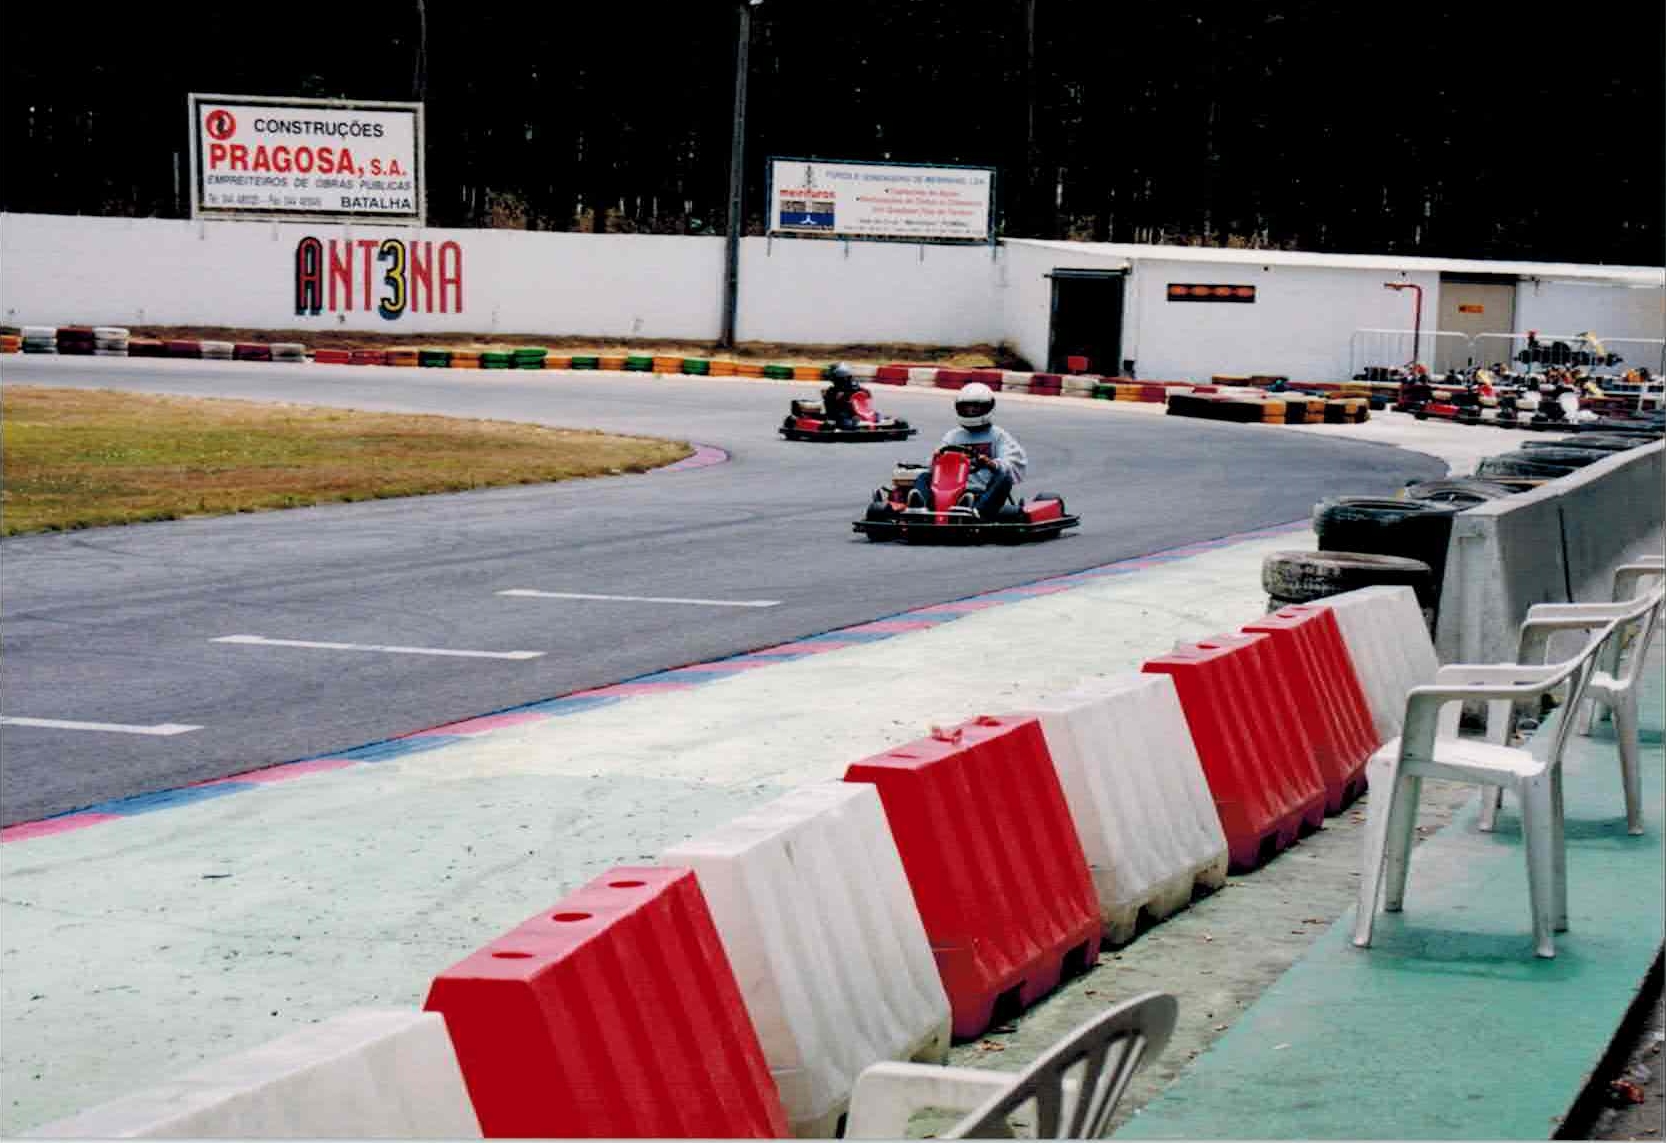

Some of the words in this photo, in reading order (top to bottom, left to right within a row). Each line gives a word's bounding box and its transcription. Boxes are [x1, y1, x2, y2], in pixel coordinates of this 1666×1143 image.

[254, 118, 384, 140] CONSTRUÇÕES
[208, 143, 364, 178] PRAGOSA,
[369, 159, 407, 177] S.A.
[207, 175, 288, 188] EMPREITEIROS
[293, 177, 309, 189] DE
[341, 195, 412, 210] BATALHA
[295, 236, 462, 320] ANT3NA
